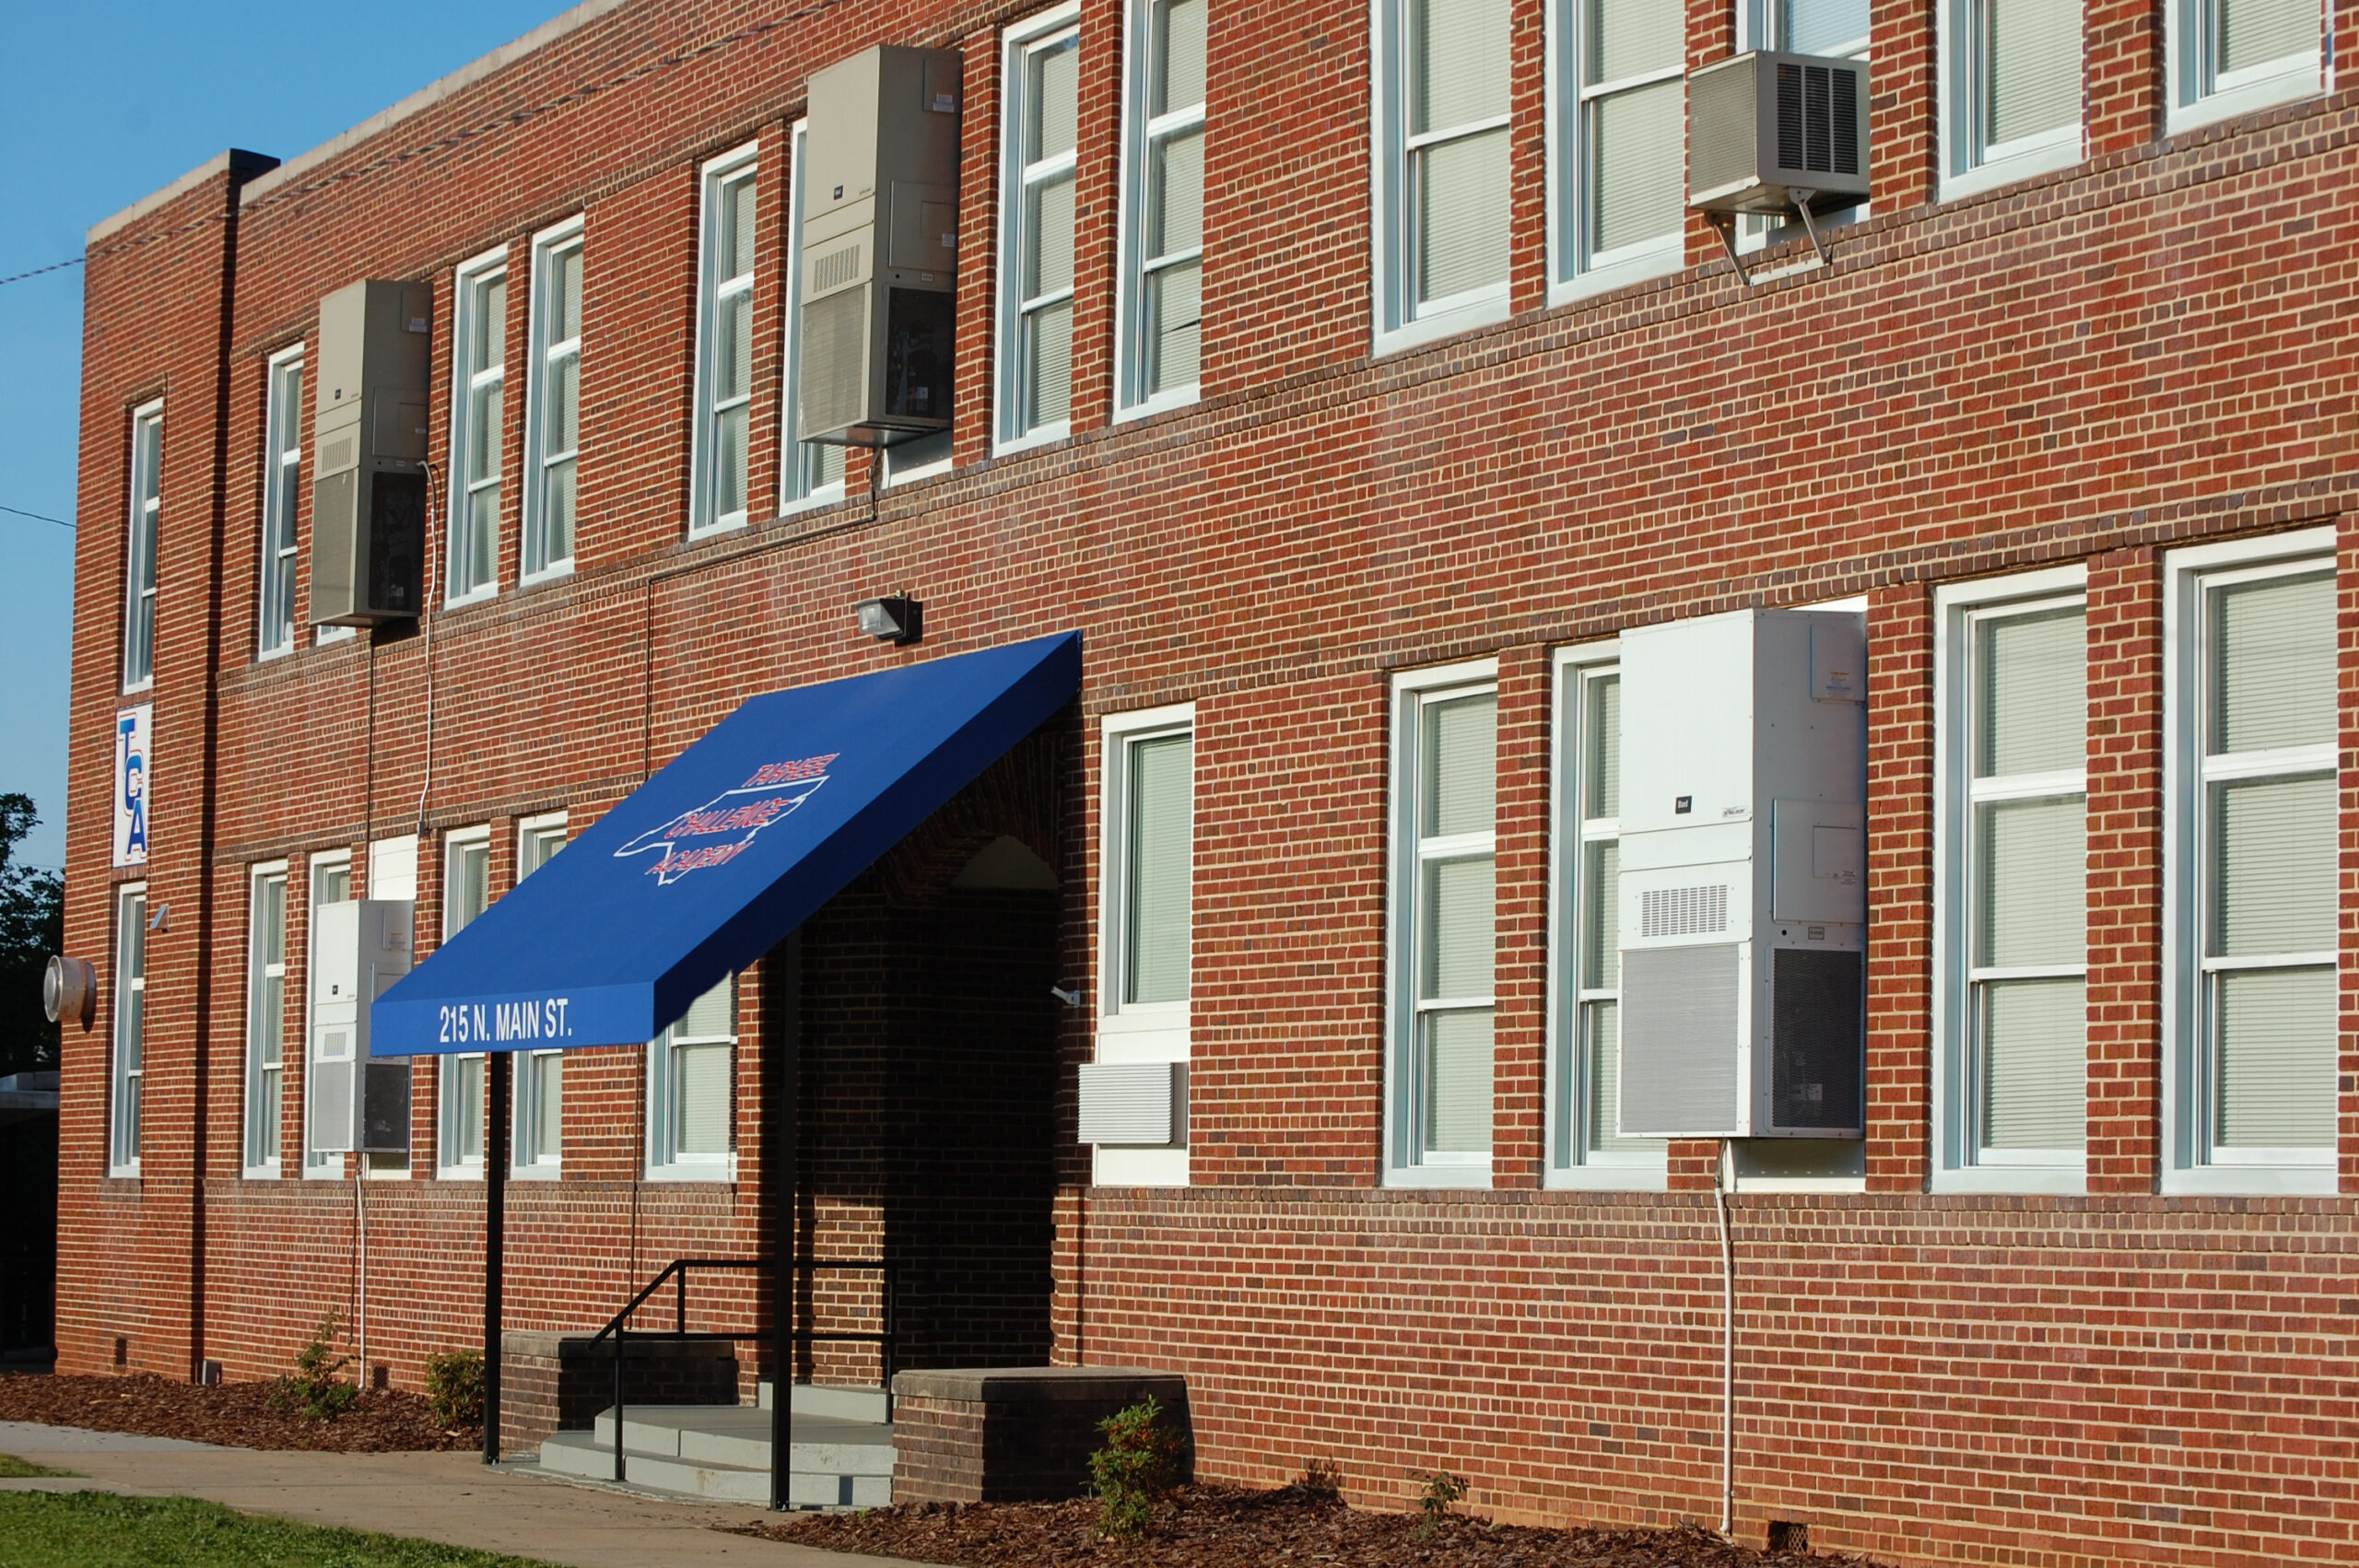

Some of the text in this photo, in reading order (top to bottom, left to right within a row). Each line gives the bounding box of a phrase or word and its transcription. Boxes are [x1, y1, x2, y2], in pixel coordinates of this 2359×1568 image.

[119, 715, 147, 858] TCA
[664, 797, 792, 838] CHALLENGE
[645, 841, 755, 875] ACADEMY
[440, 998, 572, 1043] 215 N. MAIN ST.
